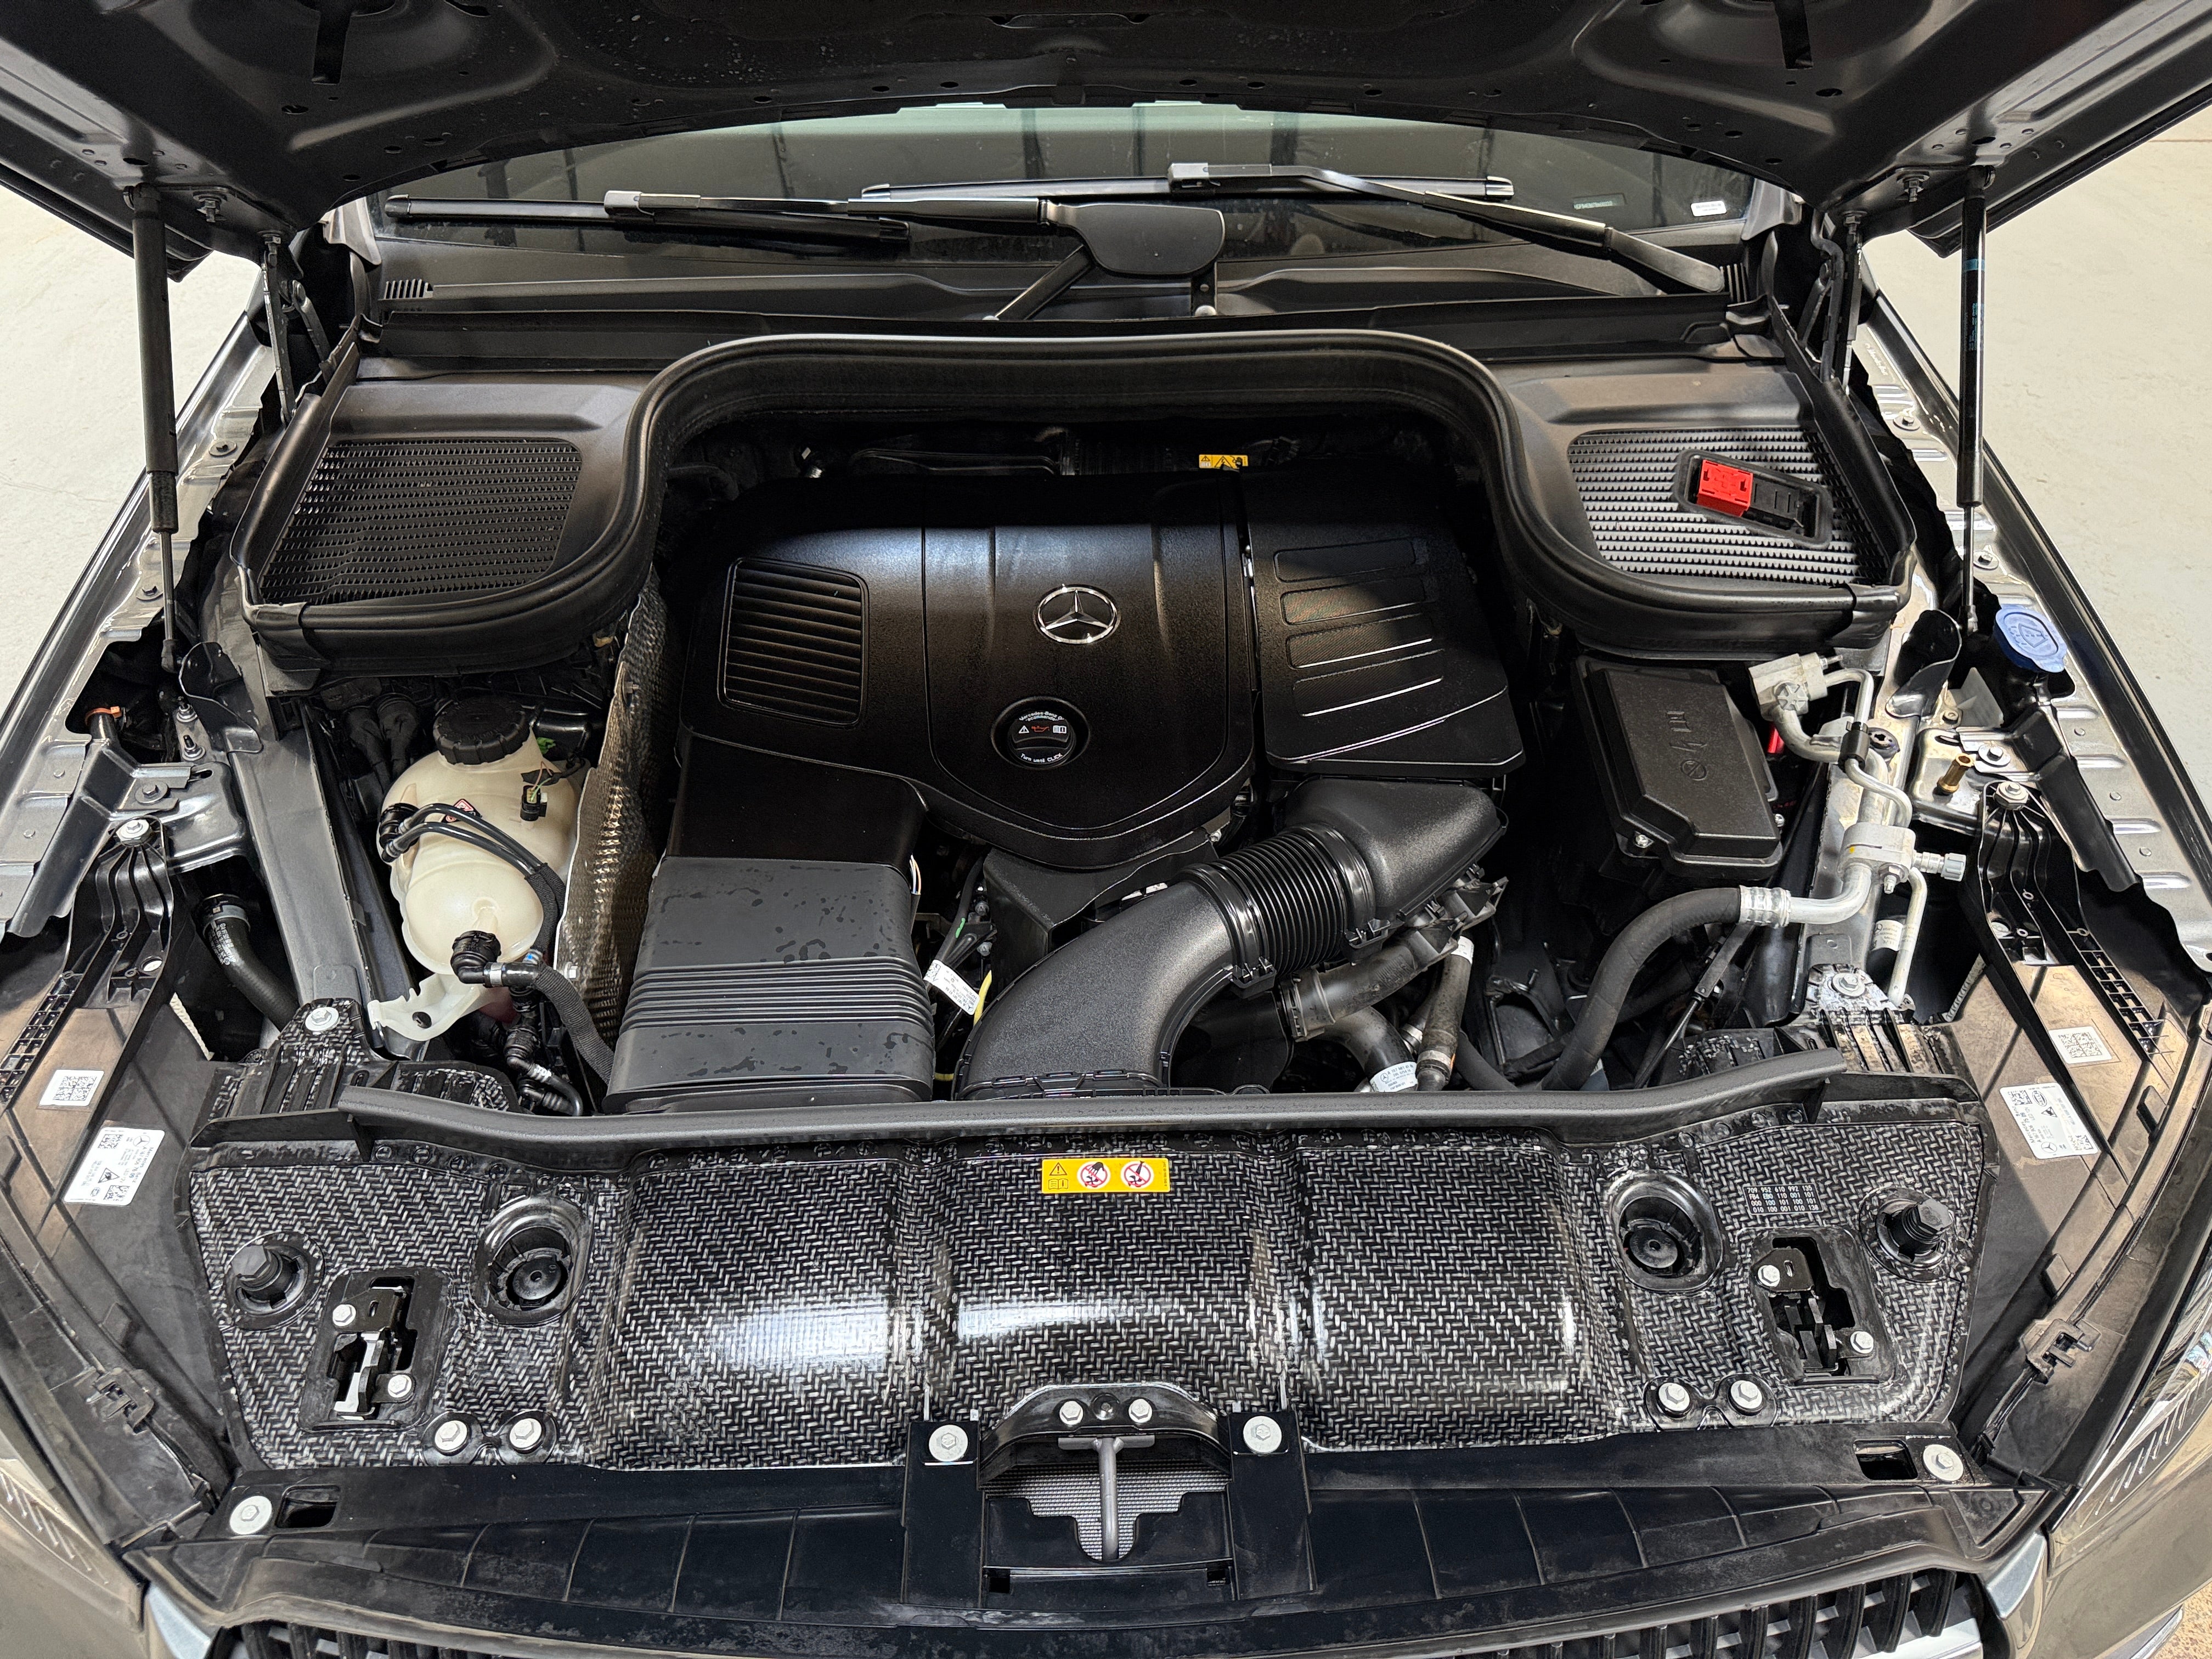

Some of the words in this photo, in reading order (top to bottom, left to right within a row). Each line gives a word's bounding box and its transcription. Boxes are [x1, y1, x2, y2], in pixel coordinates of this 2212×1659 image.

[1020, 753, 1031, 762] Turn
[1047, 753, 1063, 762] CLICK
[2012, 1106, 2020, 1116] Benz
[2021, 1121, 2035, 1143] Mercedes
[139, 1147, 154, 1167] Mercedes
